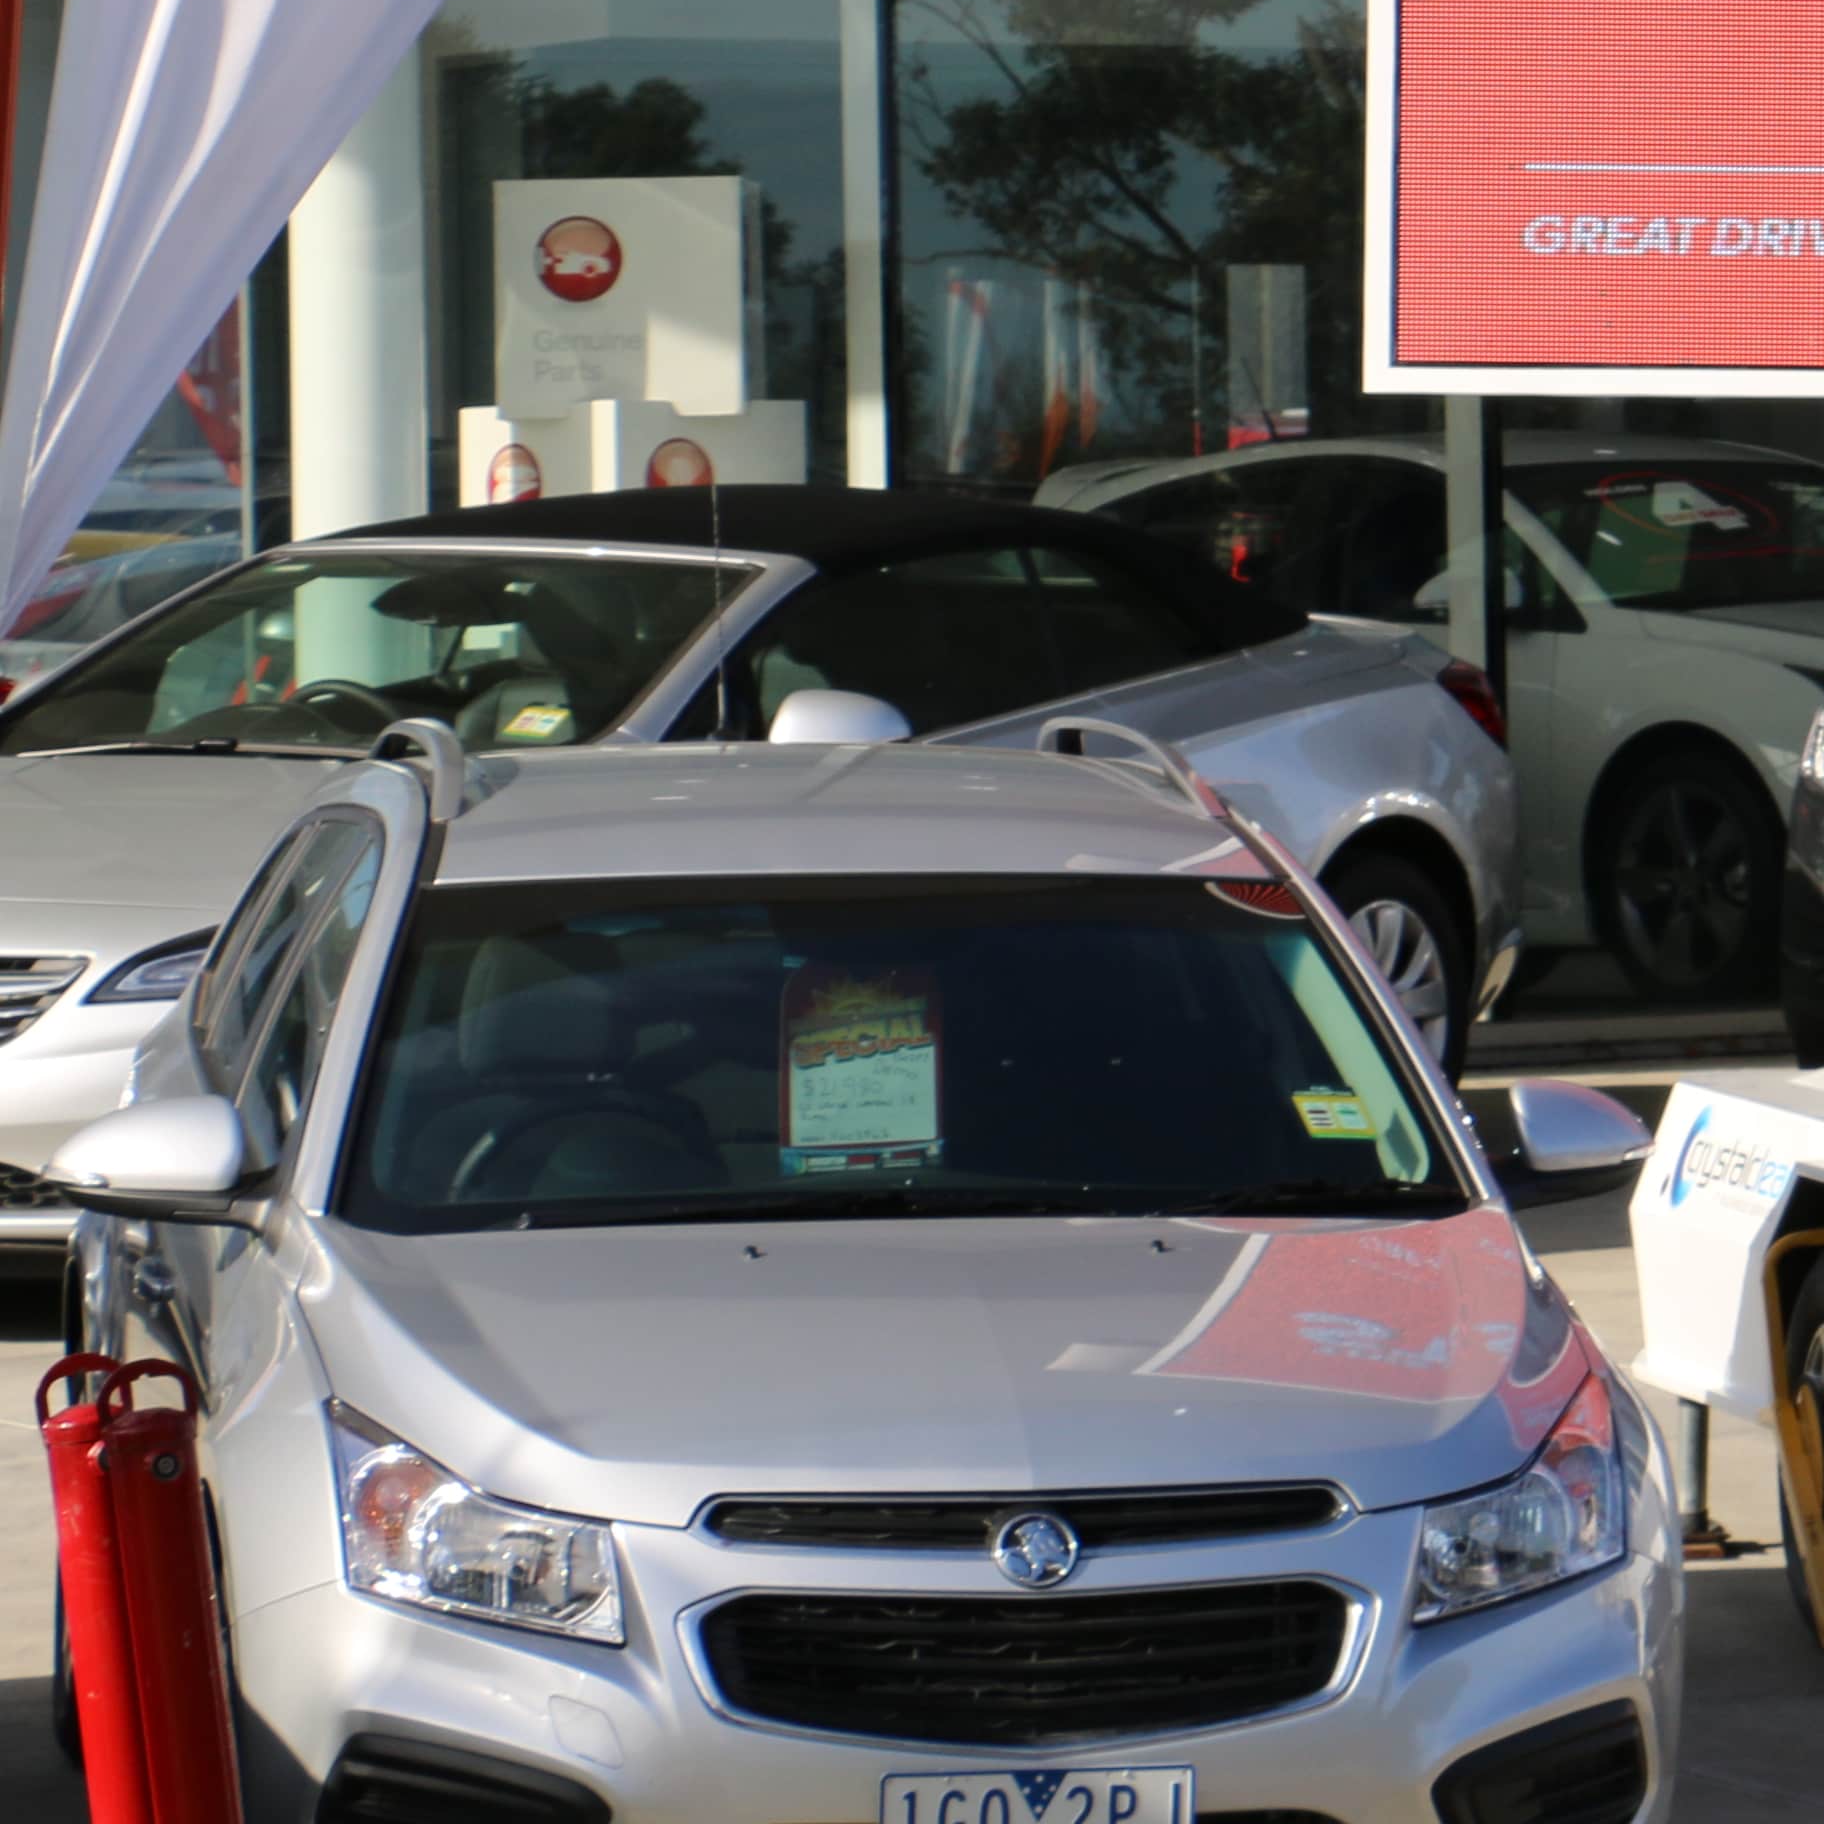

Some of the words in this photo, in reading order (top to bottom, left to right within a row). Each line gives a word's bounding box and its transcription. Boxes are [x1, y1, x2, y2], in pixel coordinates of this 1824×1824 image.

[1522, 214, 1709, 255] GREAT
[532, 328, 644, 353] Genuine
[532, 359, 603, 382] Parts
